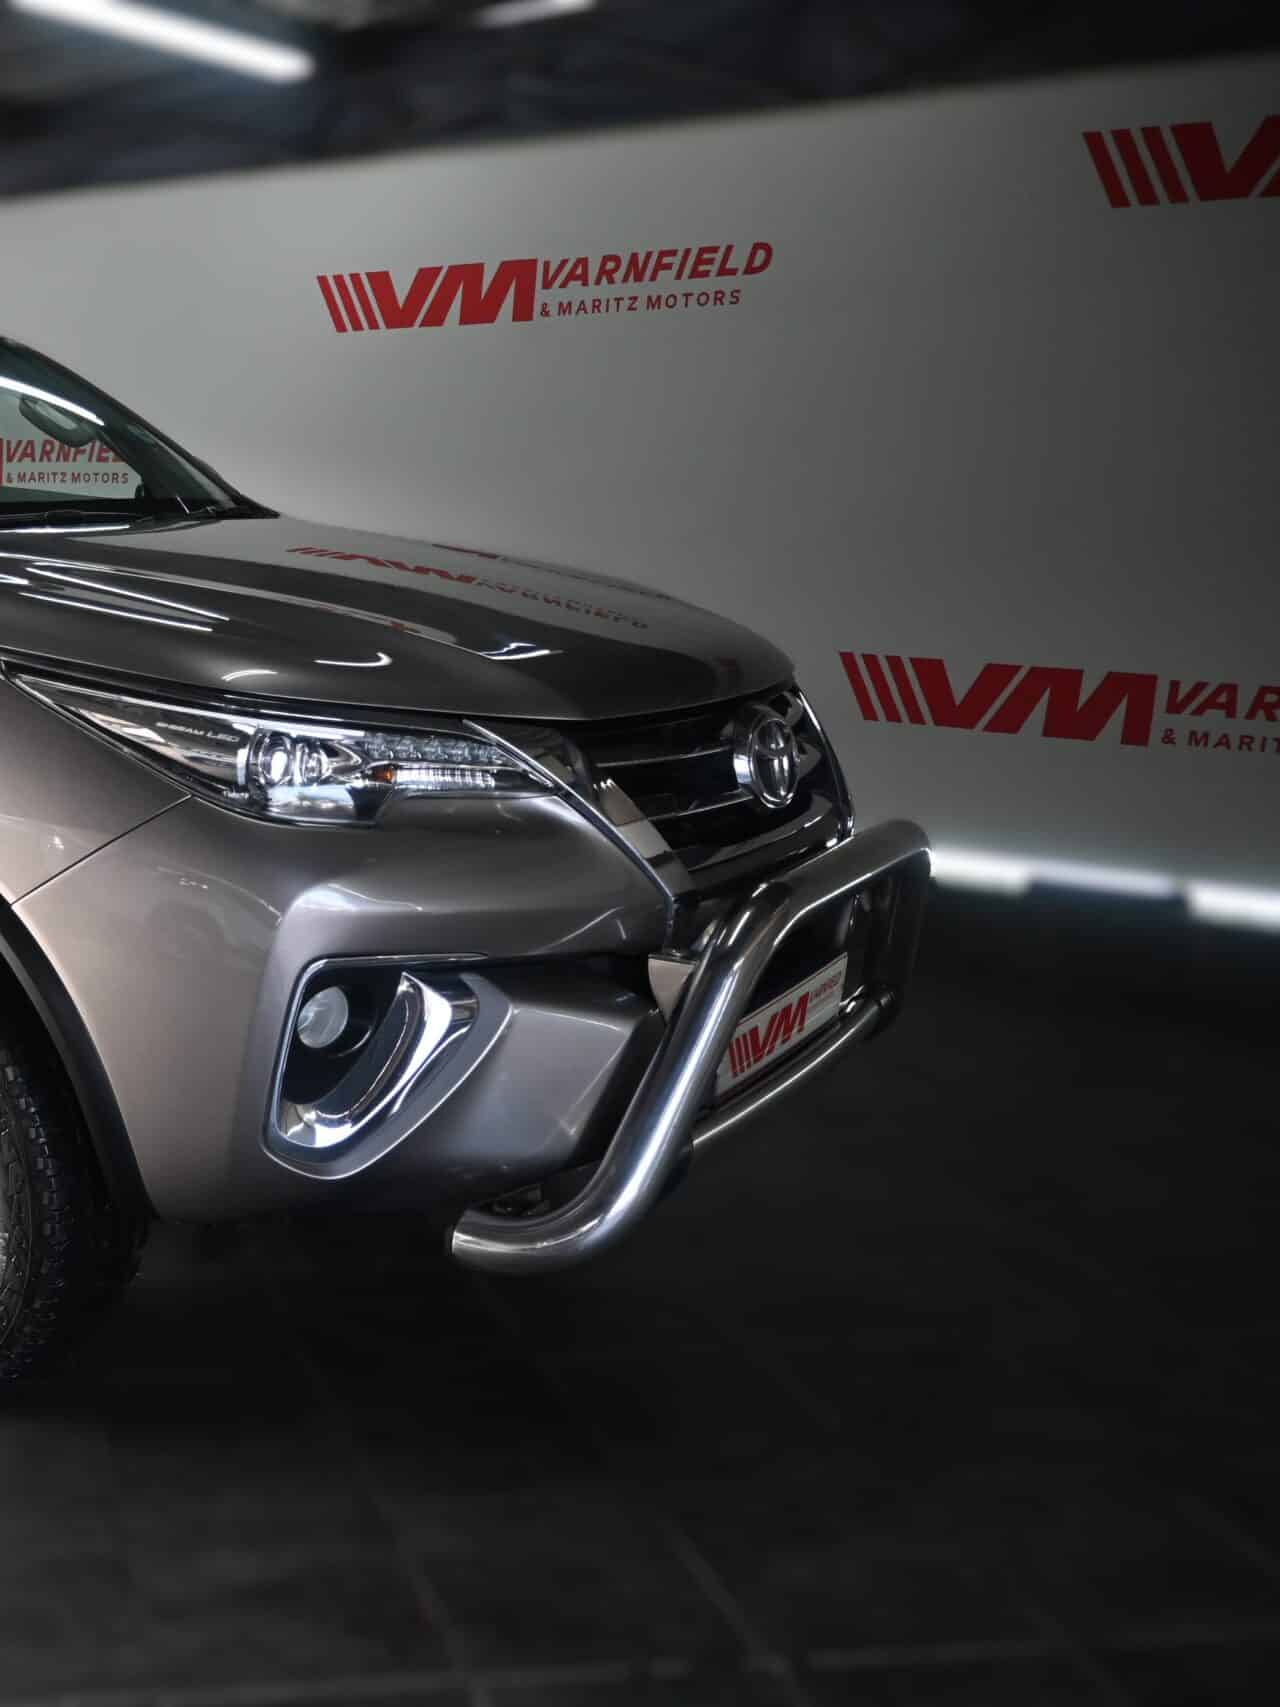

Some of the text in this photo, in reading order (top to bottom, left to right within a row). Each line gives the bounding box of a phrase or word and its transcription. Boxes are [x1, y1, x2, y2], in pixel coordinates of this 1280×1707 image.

[541, 241, 774, 290] VARNFIELD
[365, 258, 538, 329] VM
[540, 289, 741, 318] & MARITZ MOTORS
[17, 472, 68, 484] MARITZ
[71, 472, 129, 485] MOTORS
[909, 657, 1159, 748] VM
[1160, 728, 1177, 745] &
[749, 992, 811, 1064] VM
